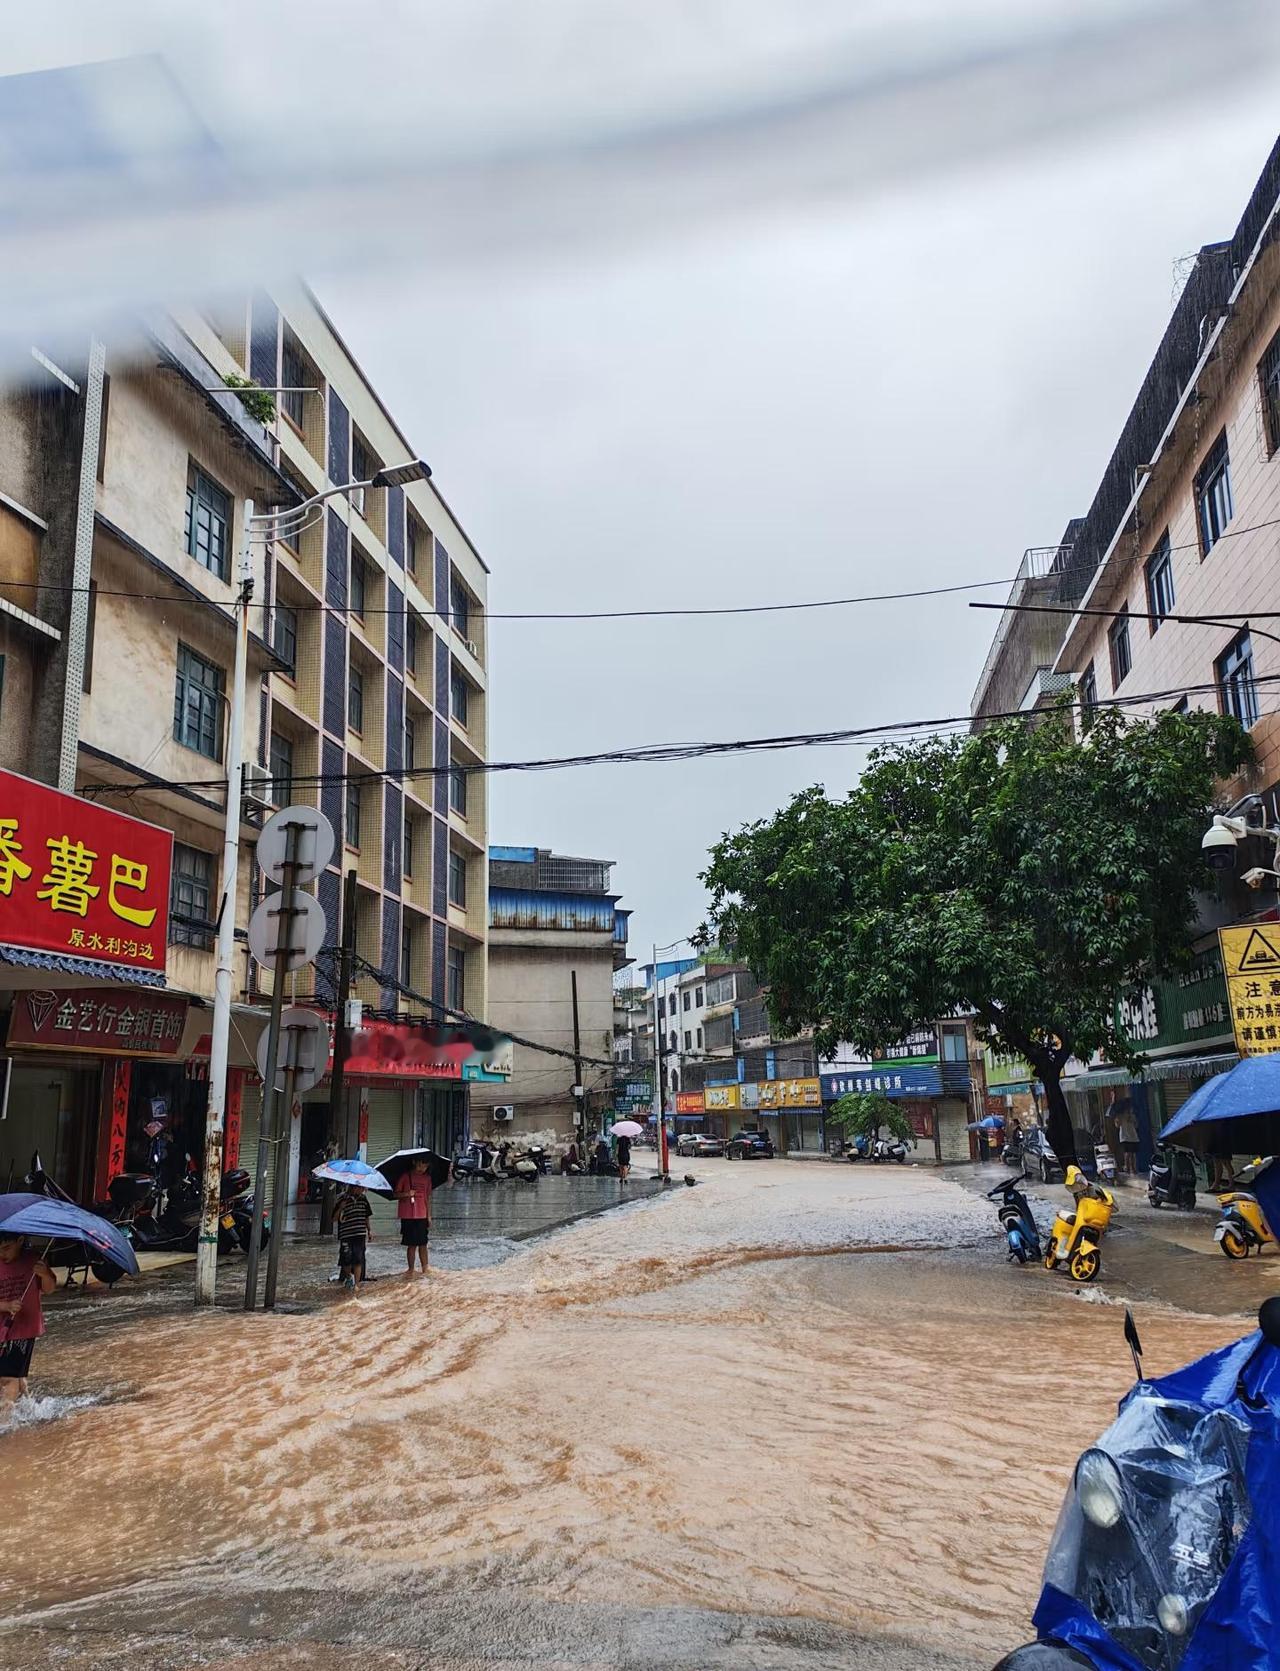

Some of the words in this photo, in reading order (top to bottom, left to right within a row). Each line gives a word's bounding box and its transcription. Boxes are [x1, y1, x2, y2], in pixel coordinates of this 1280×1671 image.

[68, 928, 154, 960] 原水利沟边
[54, 998, 182, 1040] 金艺行金银首饰
[1242, 1025, 1280, 1041] 请谨慎
